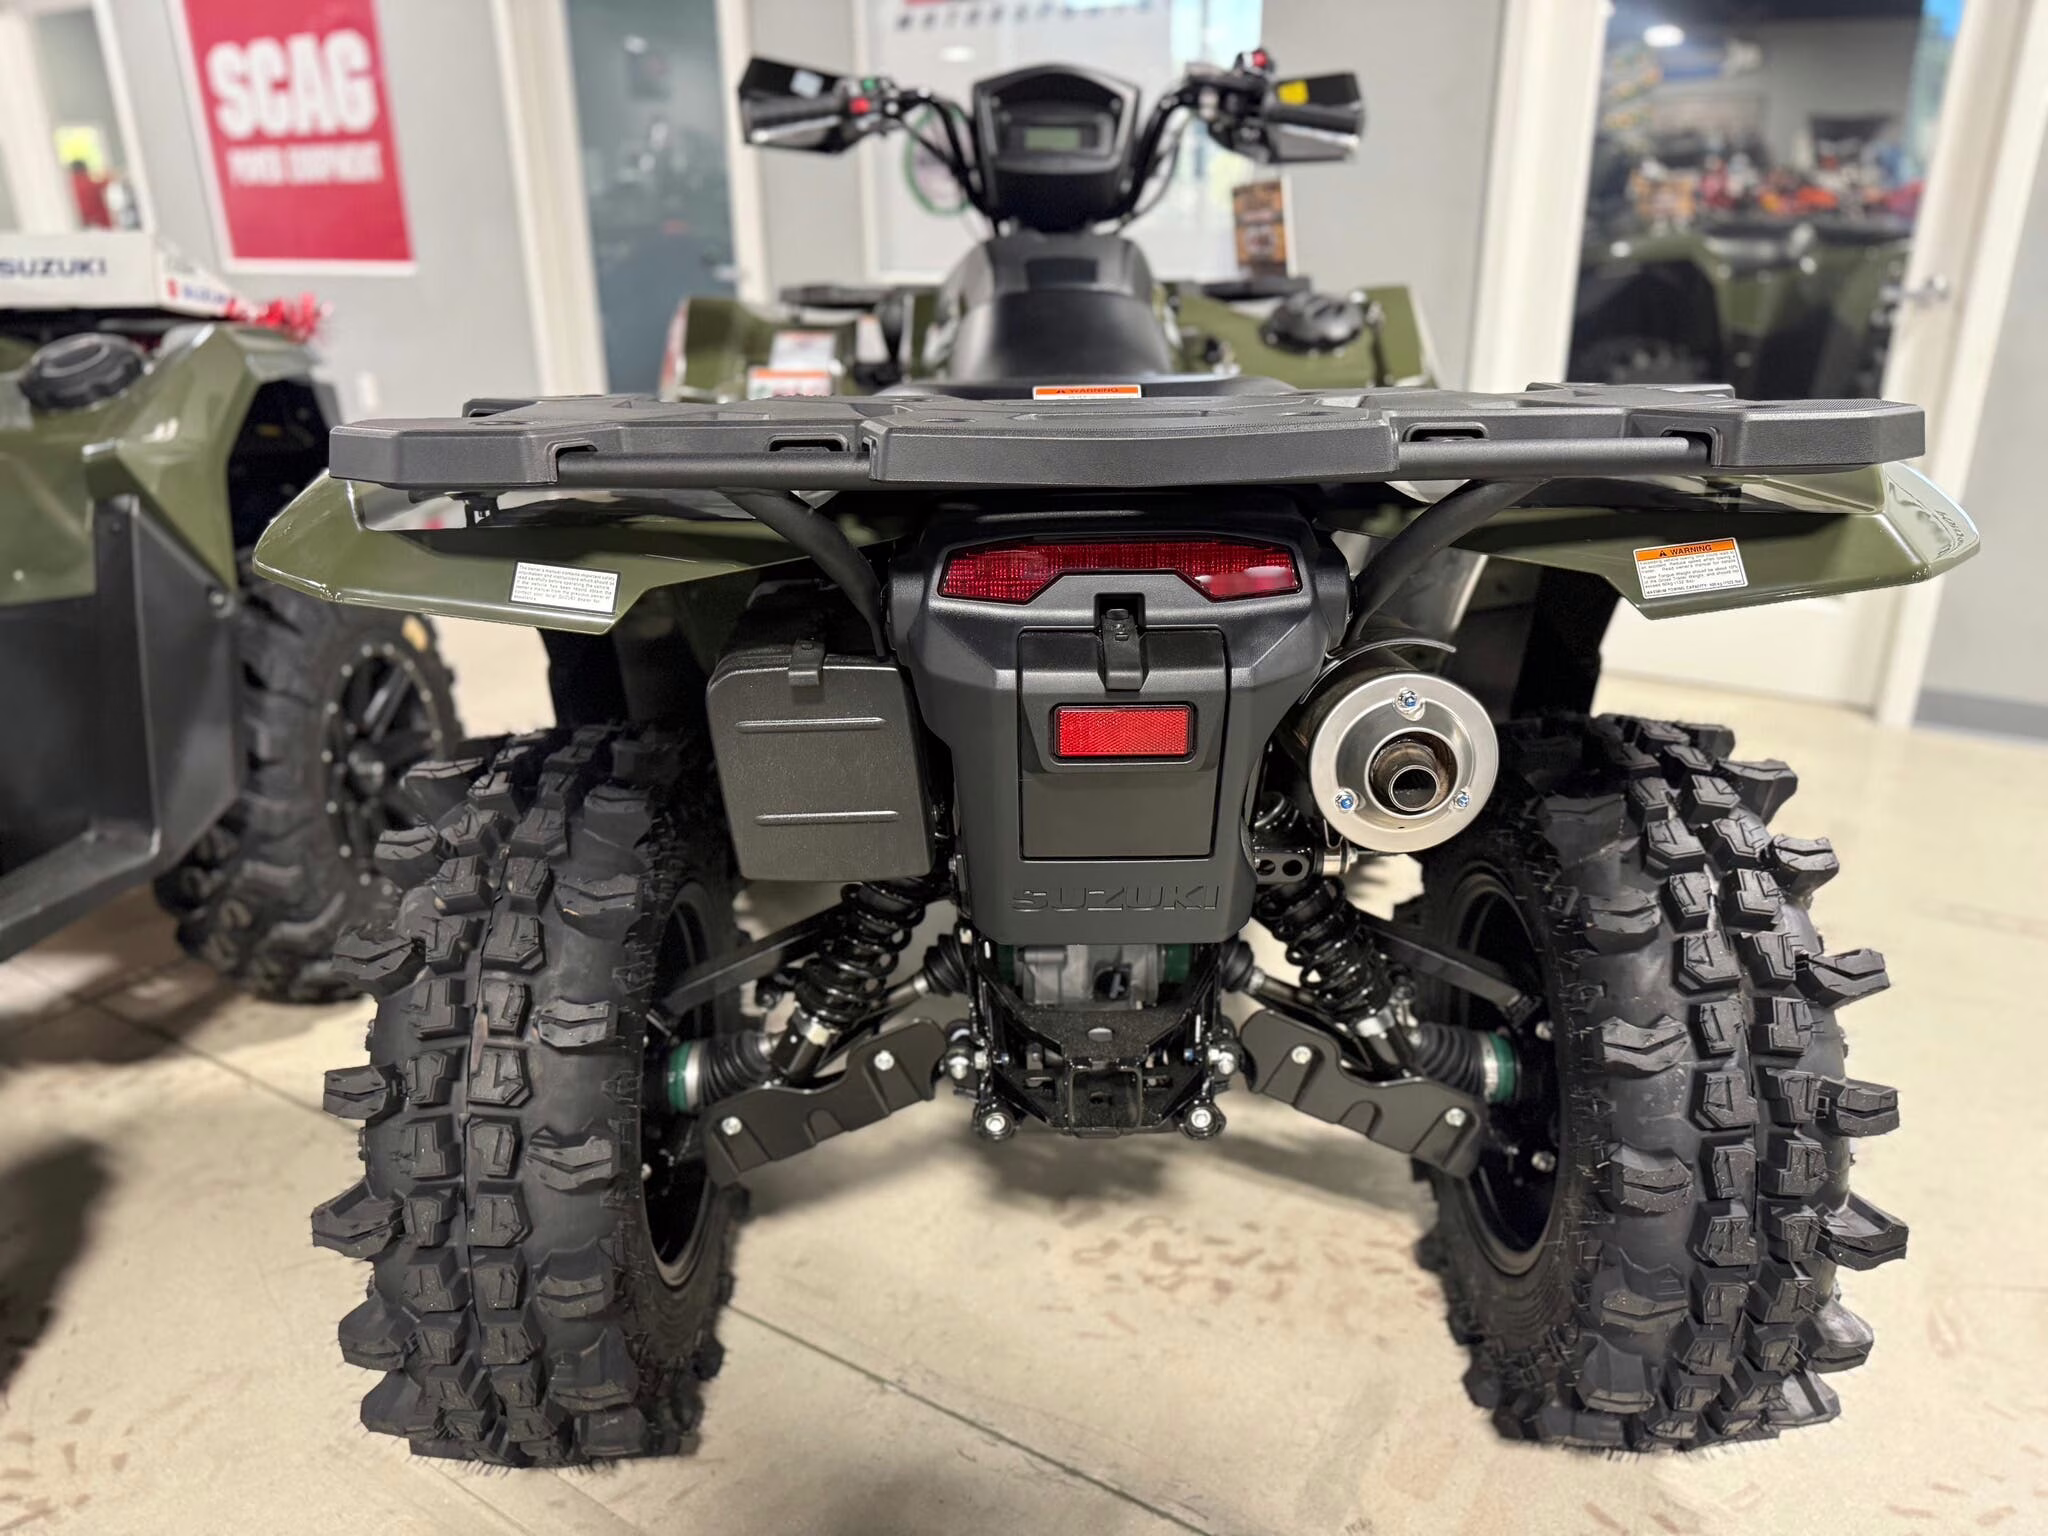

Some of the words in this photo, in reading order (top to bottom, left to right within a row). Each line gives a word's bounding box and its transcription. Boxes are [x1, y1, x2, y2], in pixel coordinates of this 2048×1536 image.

[206, 29, 379, 139] SCAG
[0, 257, 106, 279] SUZUKI
[1670, 545, 1712, 555] WARNING
[1012, 886, 1220, 912] SUZUKI
